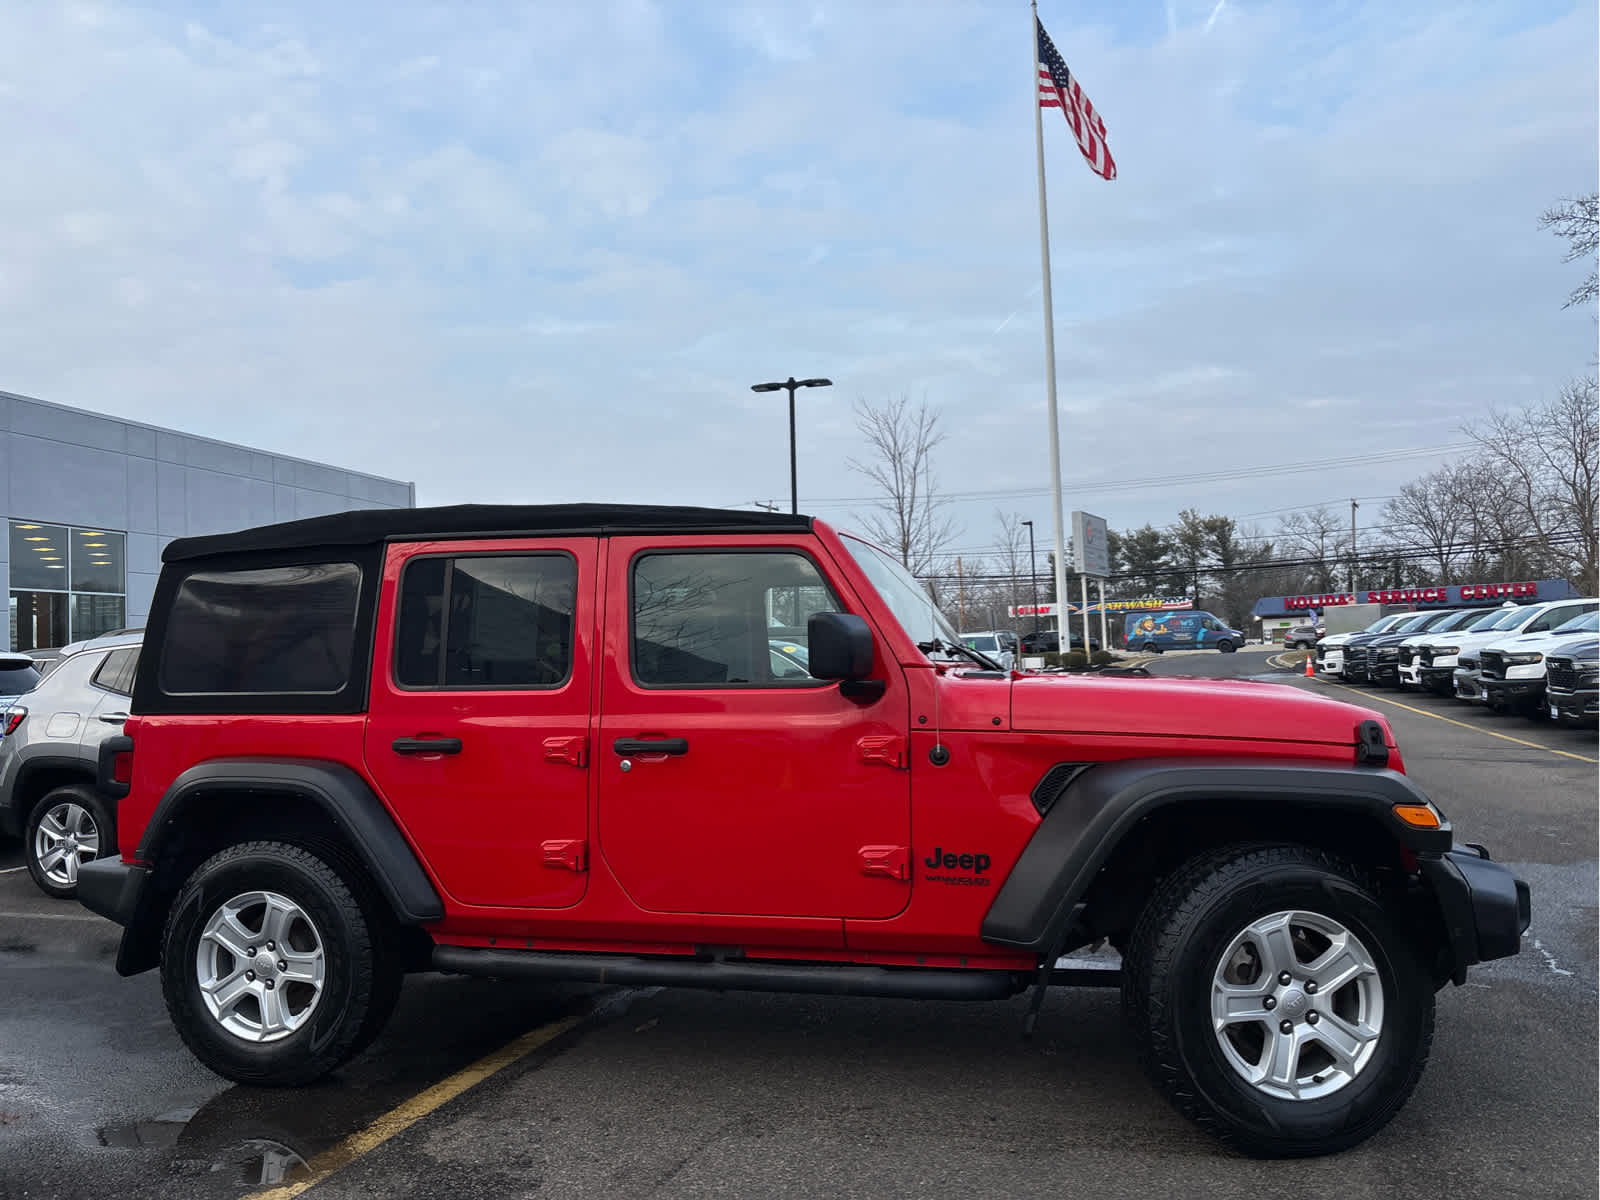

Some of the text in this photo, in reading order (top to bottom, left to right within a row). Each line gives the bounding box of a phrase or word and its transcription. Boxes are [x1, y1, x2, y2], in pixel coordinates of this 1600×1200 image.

[1368, 588, 1447, 604] SERVICE
[1460, 582, 1537, 599] CENTER
[1125, 600, 1163, 609] WASH
[925, 846, 991, 874] Jeep
